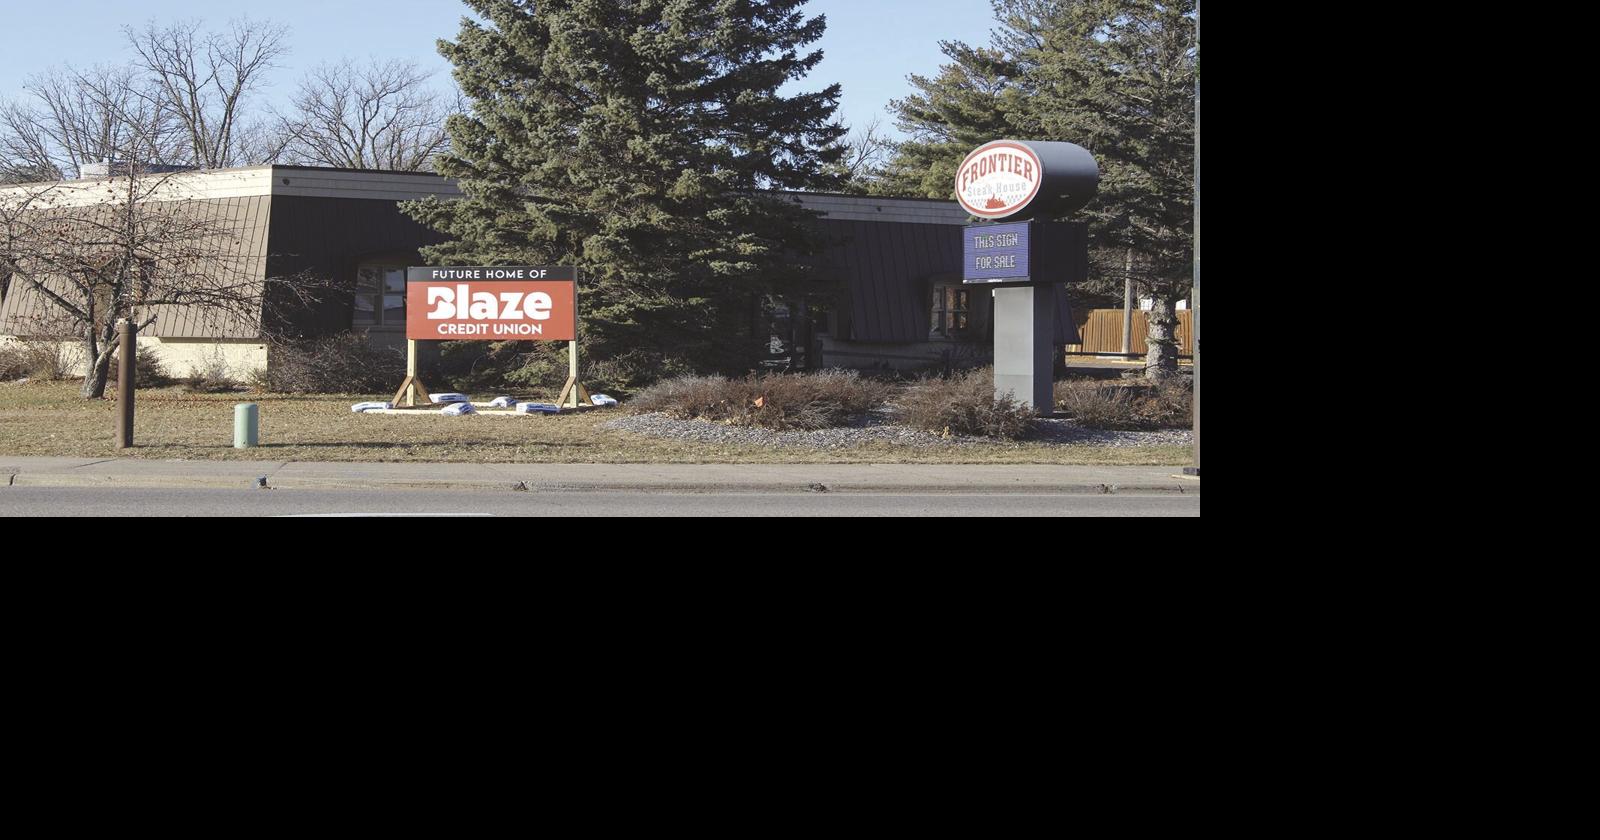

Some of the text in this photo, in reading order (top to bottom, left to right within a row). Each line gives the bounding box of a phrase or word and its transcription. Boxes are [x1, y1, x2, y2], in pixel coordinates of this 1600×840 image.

[962, 153, 1033, 192] FRONTIER
[967, 182, 1027, 197] Steak House
[974, 233, 1018, 248] THIS SIGN
[975, 255, 1015, 270] FOR SALE
[432, 269, 547, 279] FUTURE HOME OF
[427, 284, 553, 320] Blaze
[437, 323, 542, 334] CREDIT UNION
